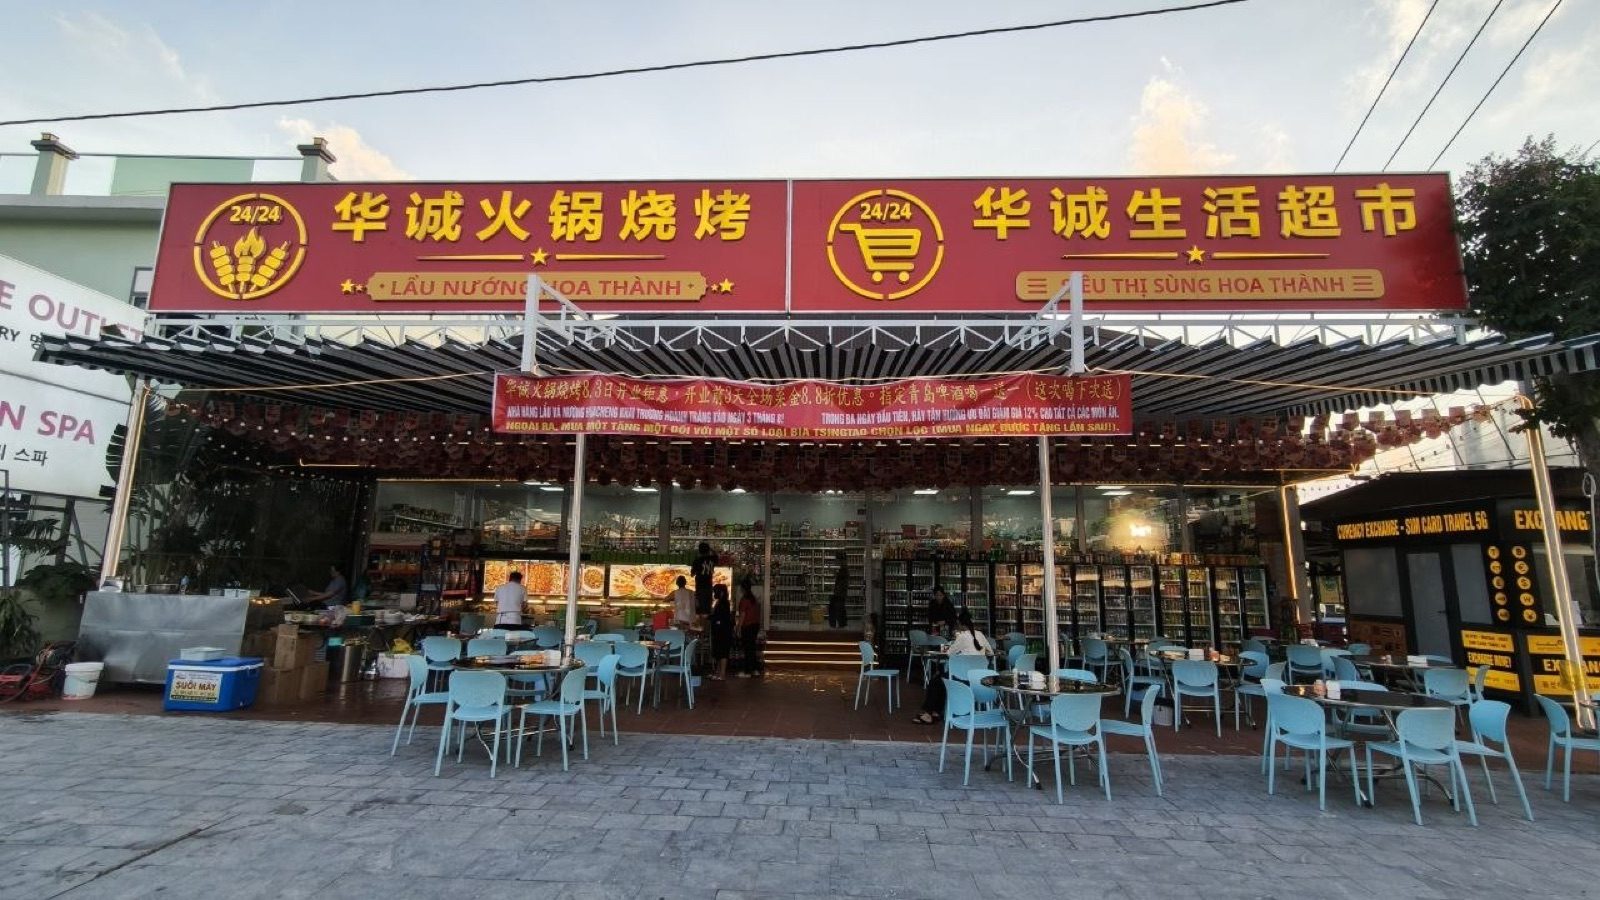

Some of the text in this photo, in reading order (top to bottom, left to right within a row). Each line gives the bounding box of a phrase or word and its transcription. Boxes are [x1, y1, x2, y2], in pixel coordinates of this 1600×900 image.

[229, 205, 281, 224] 24/24
[332, 189, 751, 242] 华诚火锅烧烤
[860, 202, 912, 221] 24/24
[973, 183, 1417, 240] 华诚生活超市
[391, 274, 435, 296] LẨU
[599, 275, 681, 296] THÀNH
[1061, 273, 1345, 298] ÊU THỊ SÙNG HOA THÀNH
[28, 293, 143, 343] OUTT
[37, 411, 95, 445] SPA
[747, 411, 752, 424] 3
[846, 413, 855, 424] BA
[561, 422, 583, 431] MUA
[790, 427, 809, 436] BIA
[813, 428, 867, 437] TSINGTAO
[14, 448, 48, 466] 스파
[1514, 509, 1590, 531] EXCANG
